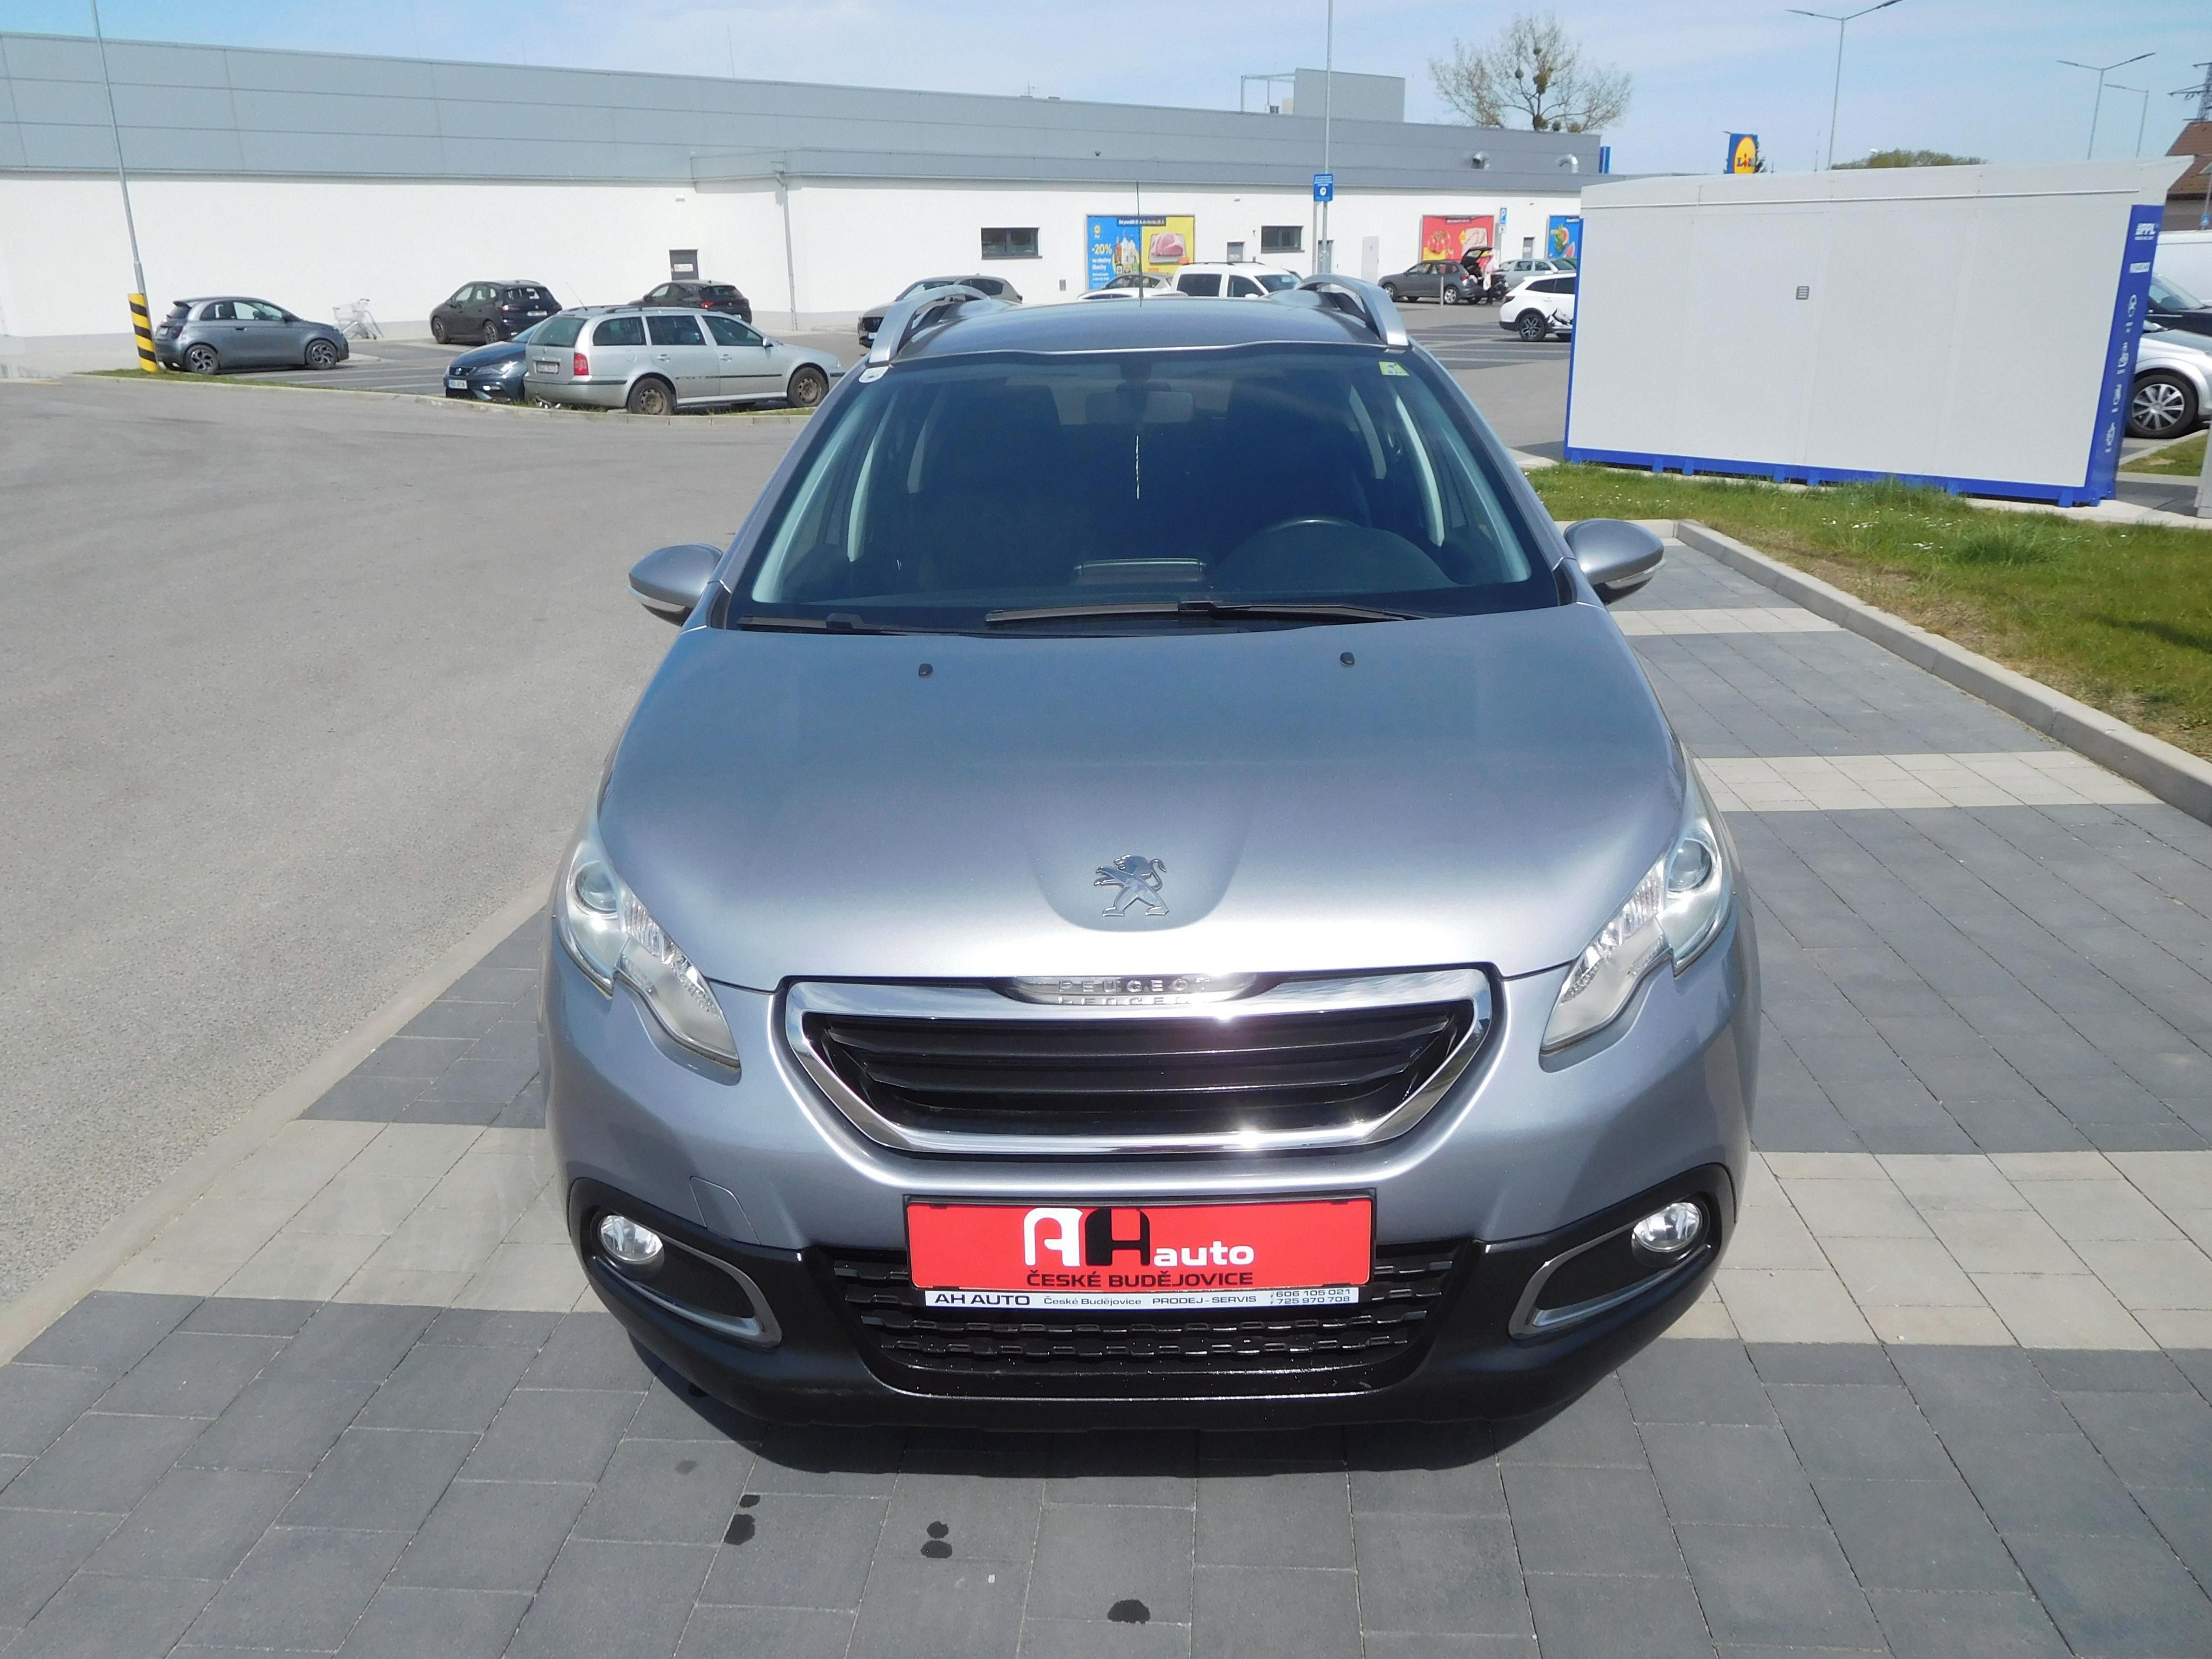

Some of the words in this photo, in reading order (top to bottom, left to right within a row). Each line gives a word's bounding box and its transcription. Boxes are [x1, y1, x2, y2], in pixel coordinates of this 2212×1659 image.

[1091, 243, 1112, 254] -20%
[1058, 977, 1211, 993] PEUGEOT
[1026, 1270, 1101, 1287] ČESKÉ
[1108, 1270, 1253, 1287] BUDĚJOVICE
[934, 1294, 966, 1304] AH
[970, 1294, 1031, 1305] AUTO
[1043, 1296, 1078, 1305] České
[1081, 1298, 1142, 1306] Budějovice
